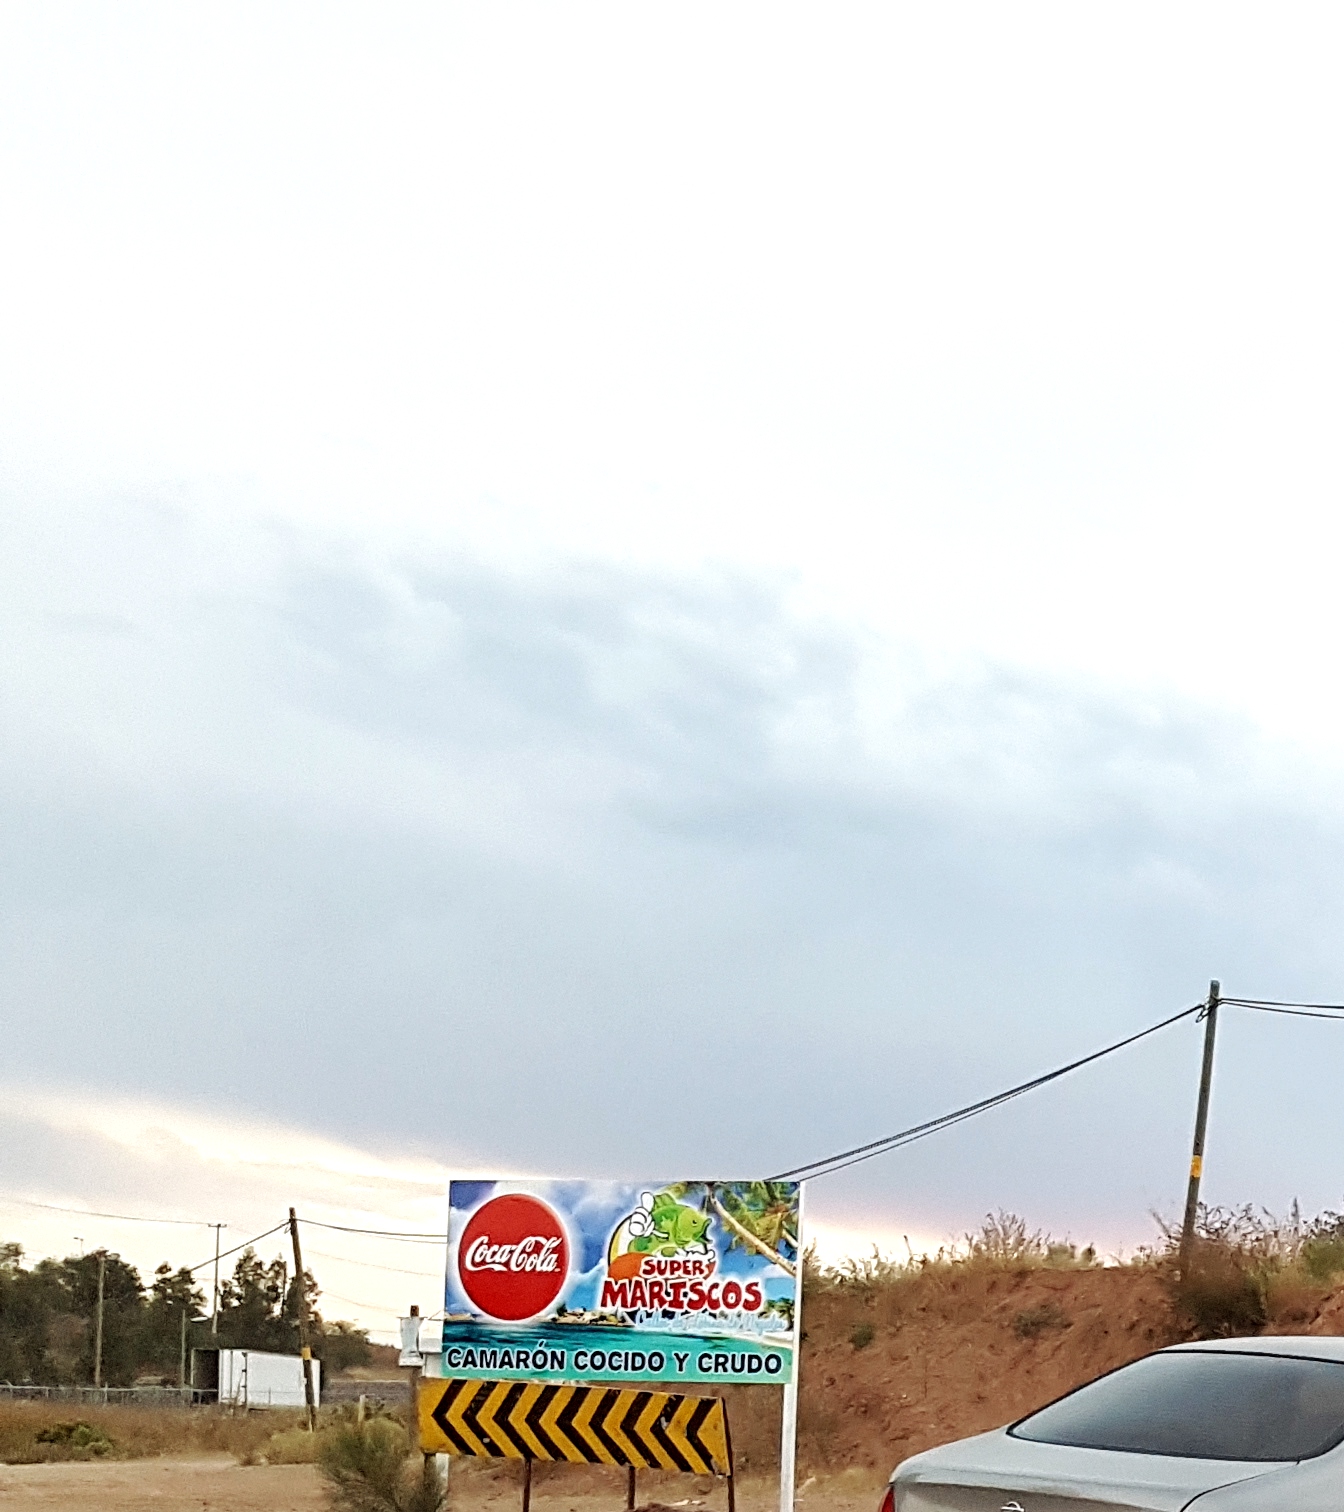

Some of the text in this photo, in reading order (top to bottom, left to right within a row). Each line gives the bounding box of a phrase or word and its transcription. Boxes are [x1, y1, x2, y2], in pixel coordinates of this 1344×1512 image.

[465, 1235, 562, 1272] Coca-Cola
[643, 1258, 703, 1277] SUPER
[601, 1279, 762, 1311] MARISCOS
[447, 1340, 782, 1375] CAMARÓN COCIDO Y CRUDO
